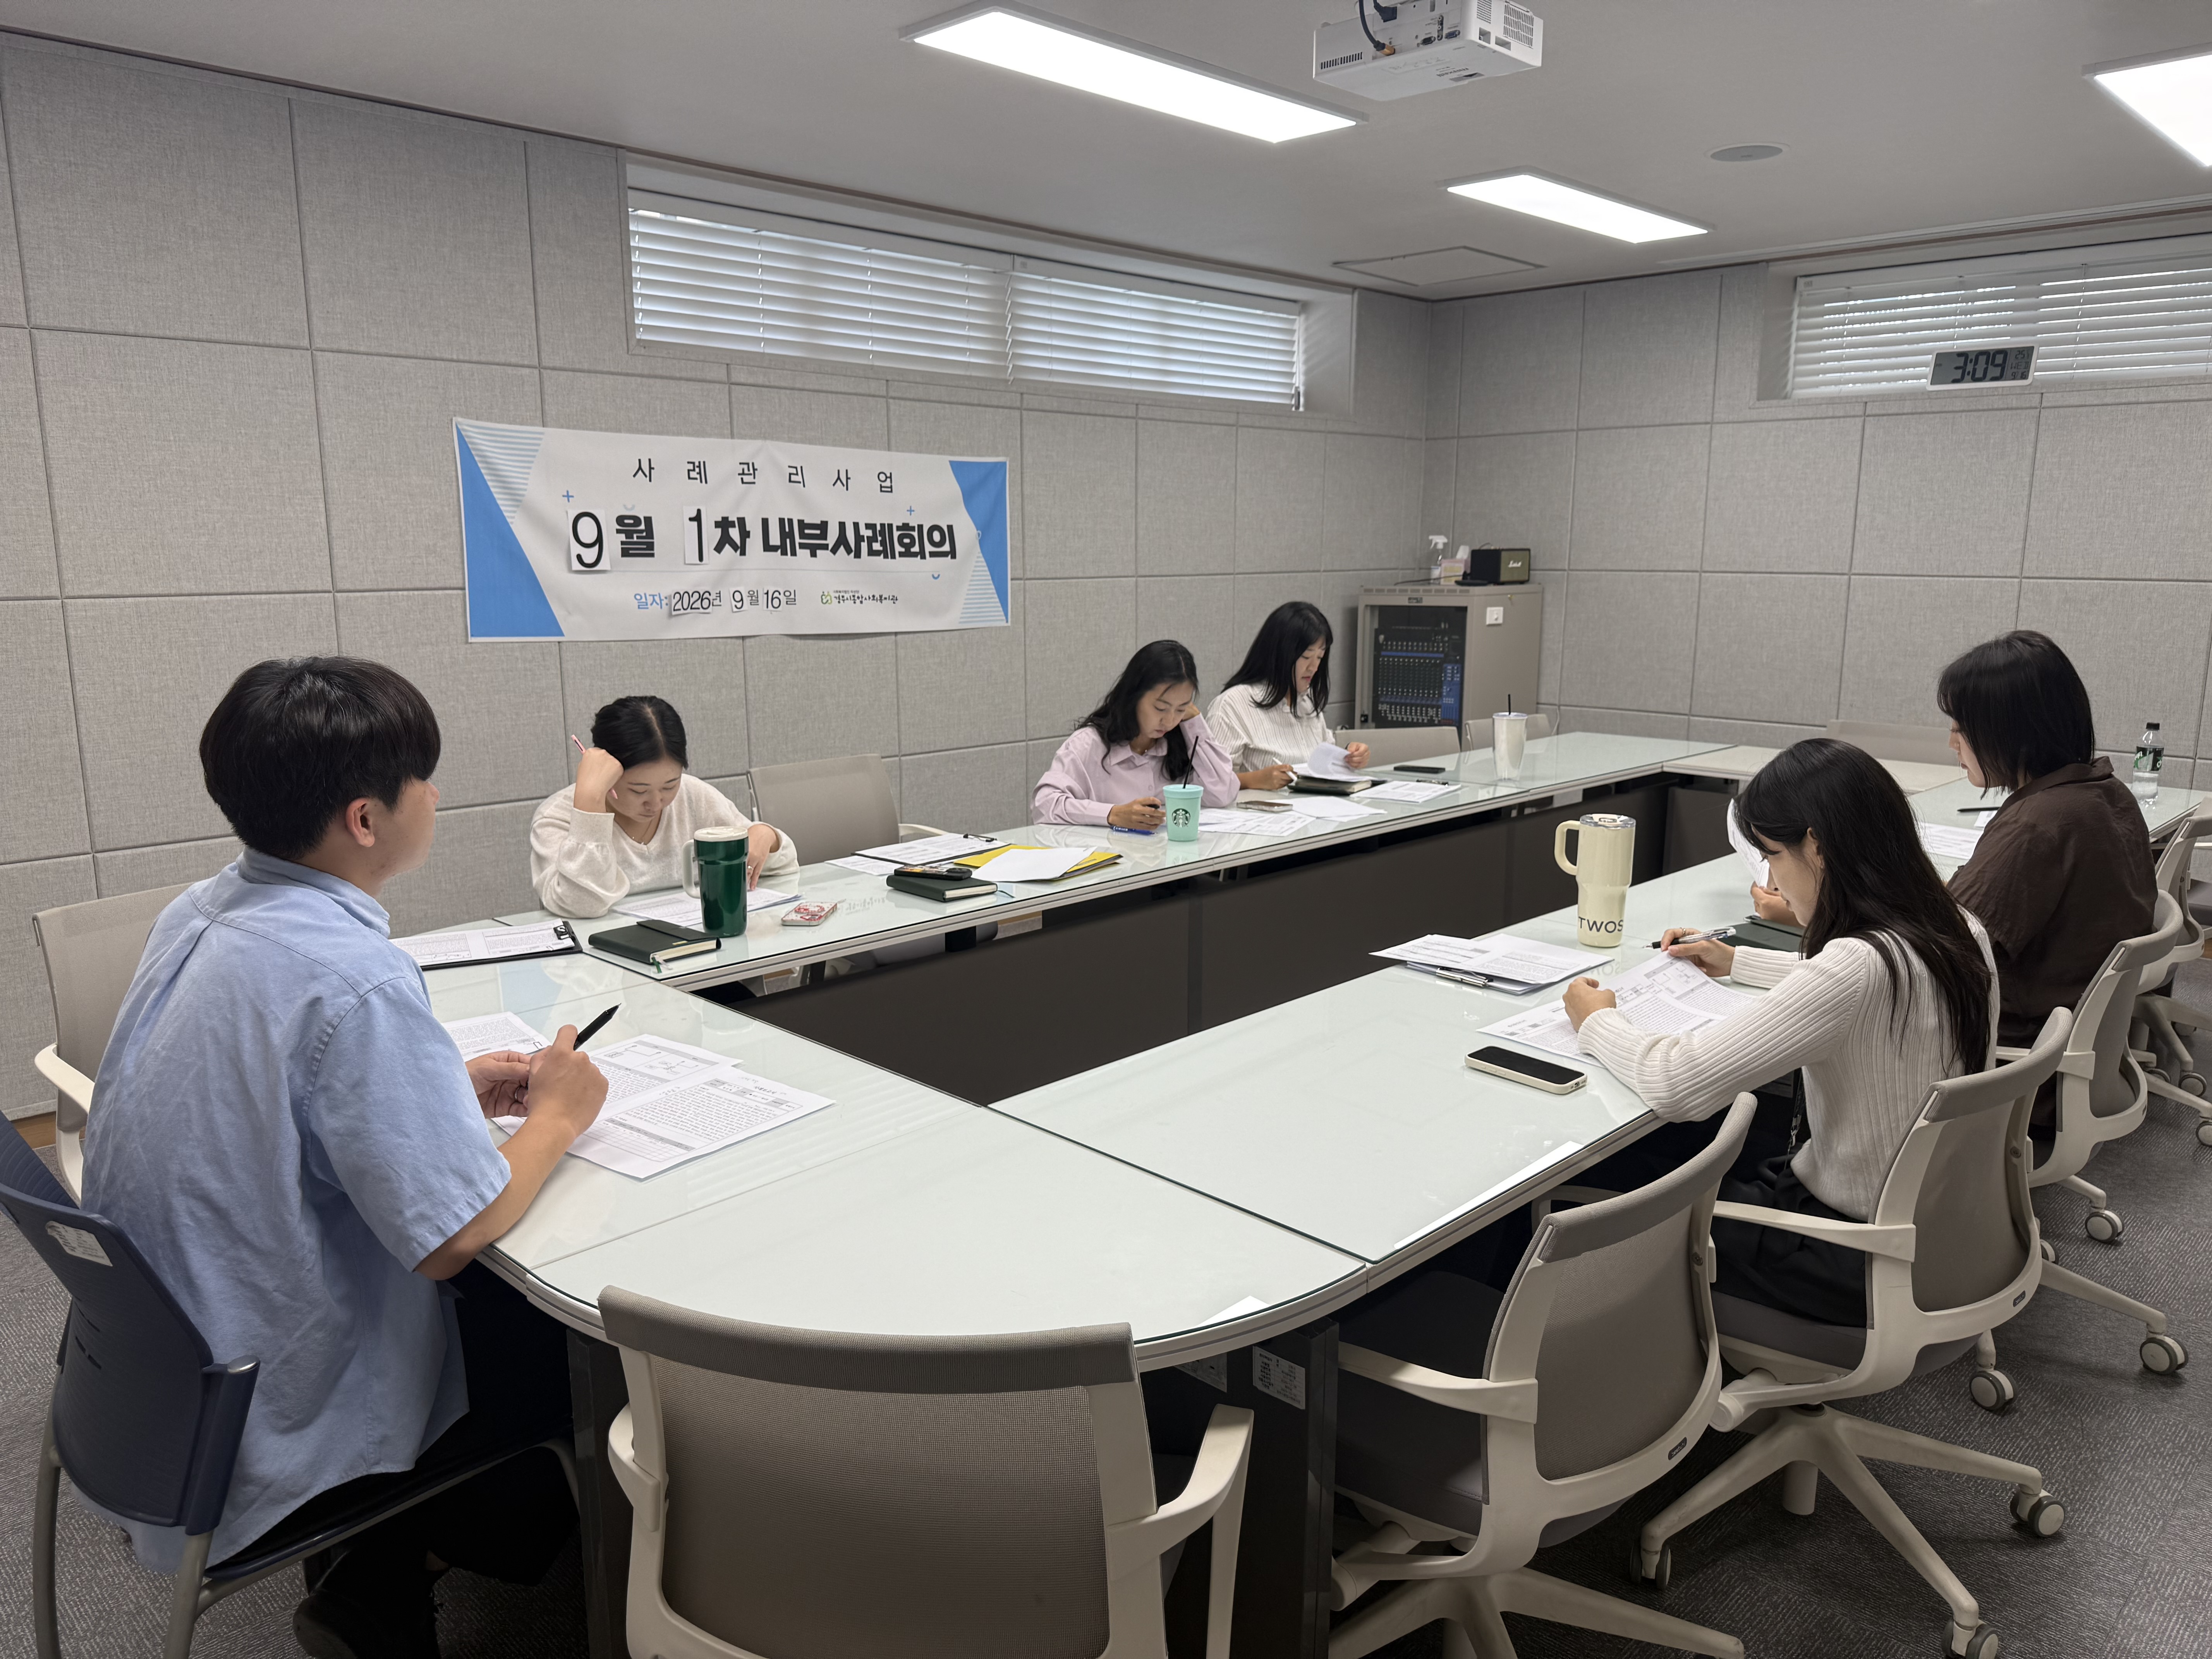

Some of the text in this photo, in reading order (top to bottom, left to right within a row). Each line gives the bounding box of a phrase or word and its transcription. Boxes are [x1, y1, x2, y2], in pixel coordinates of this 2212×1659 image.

[1951, 350, 2008, 383] 3:09
[572, 508, 957, 568] 9월 1차 내부사례회의
[634, 589, 797, 611] 일자: 2026년 9월 16일
[1578, 916, 1624, 933] TWOS
